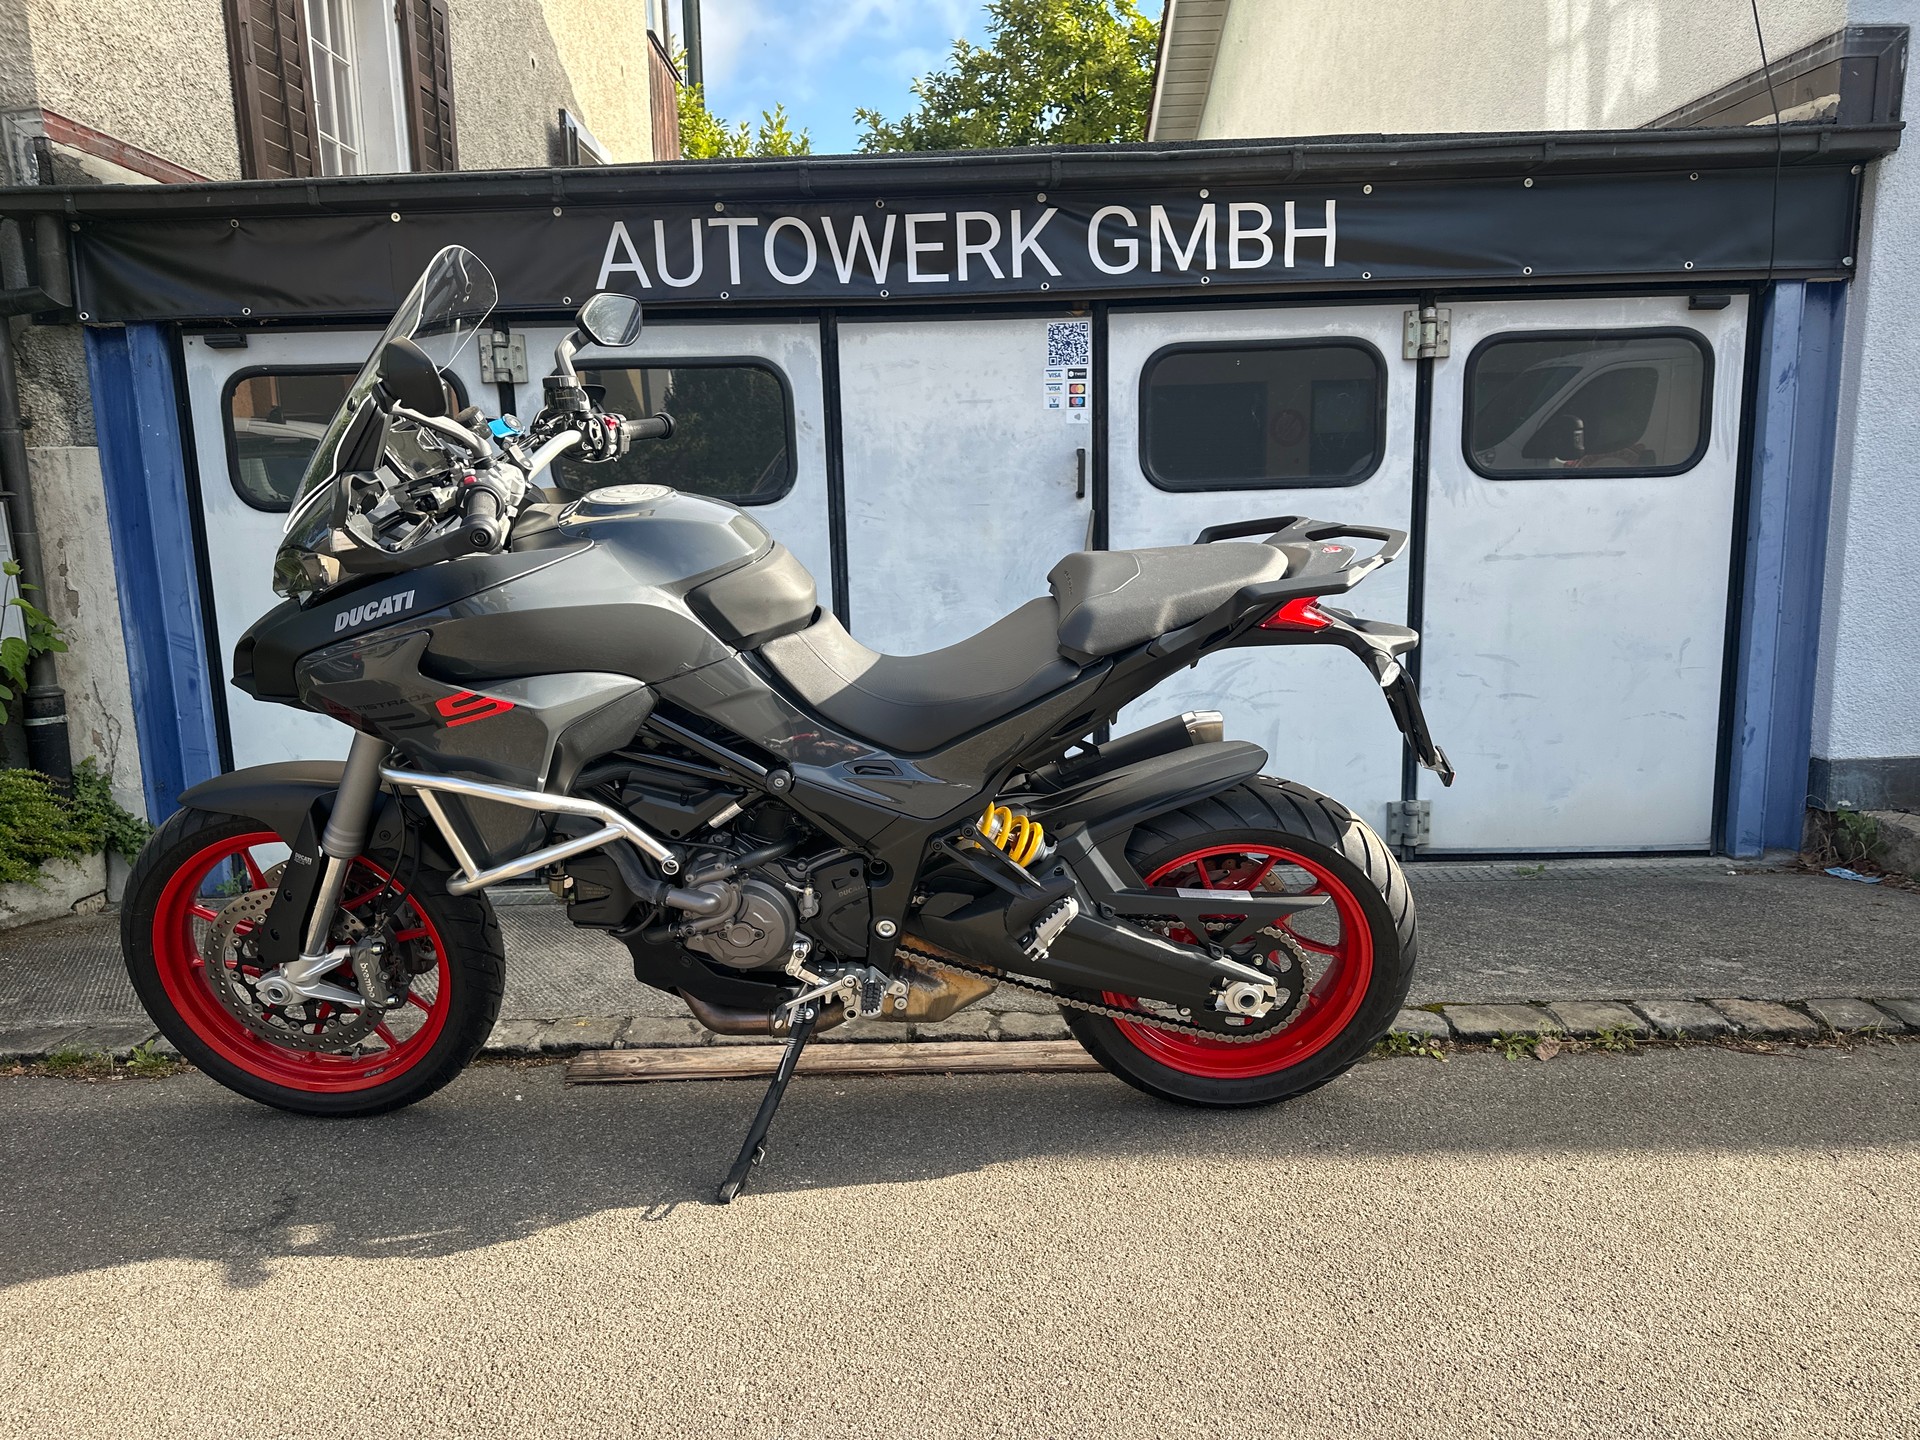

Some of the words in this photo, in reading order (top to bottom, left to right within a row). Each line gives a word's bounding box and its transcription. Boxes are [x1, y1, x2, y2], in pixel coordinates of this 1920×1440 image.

[595, 207, 1063, 290] AUTOWERK
[1087, 200, 1336, 275] GMBH
[334, 590, 415, 632] DUCATI
[360, 962, 376, 998] brembo
